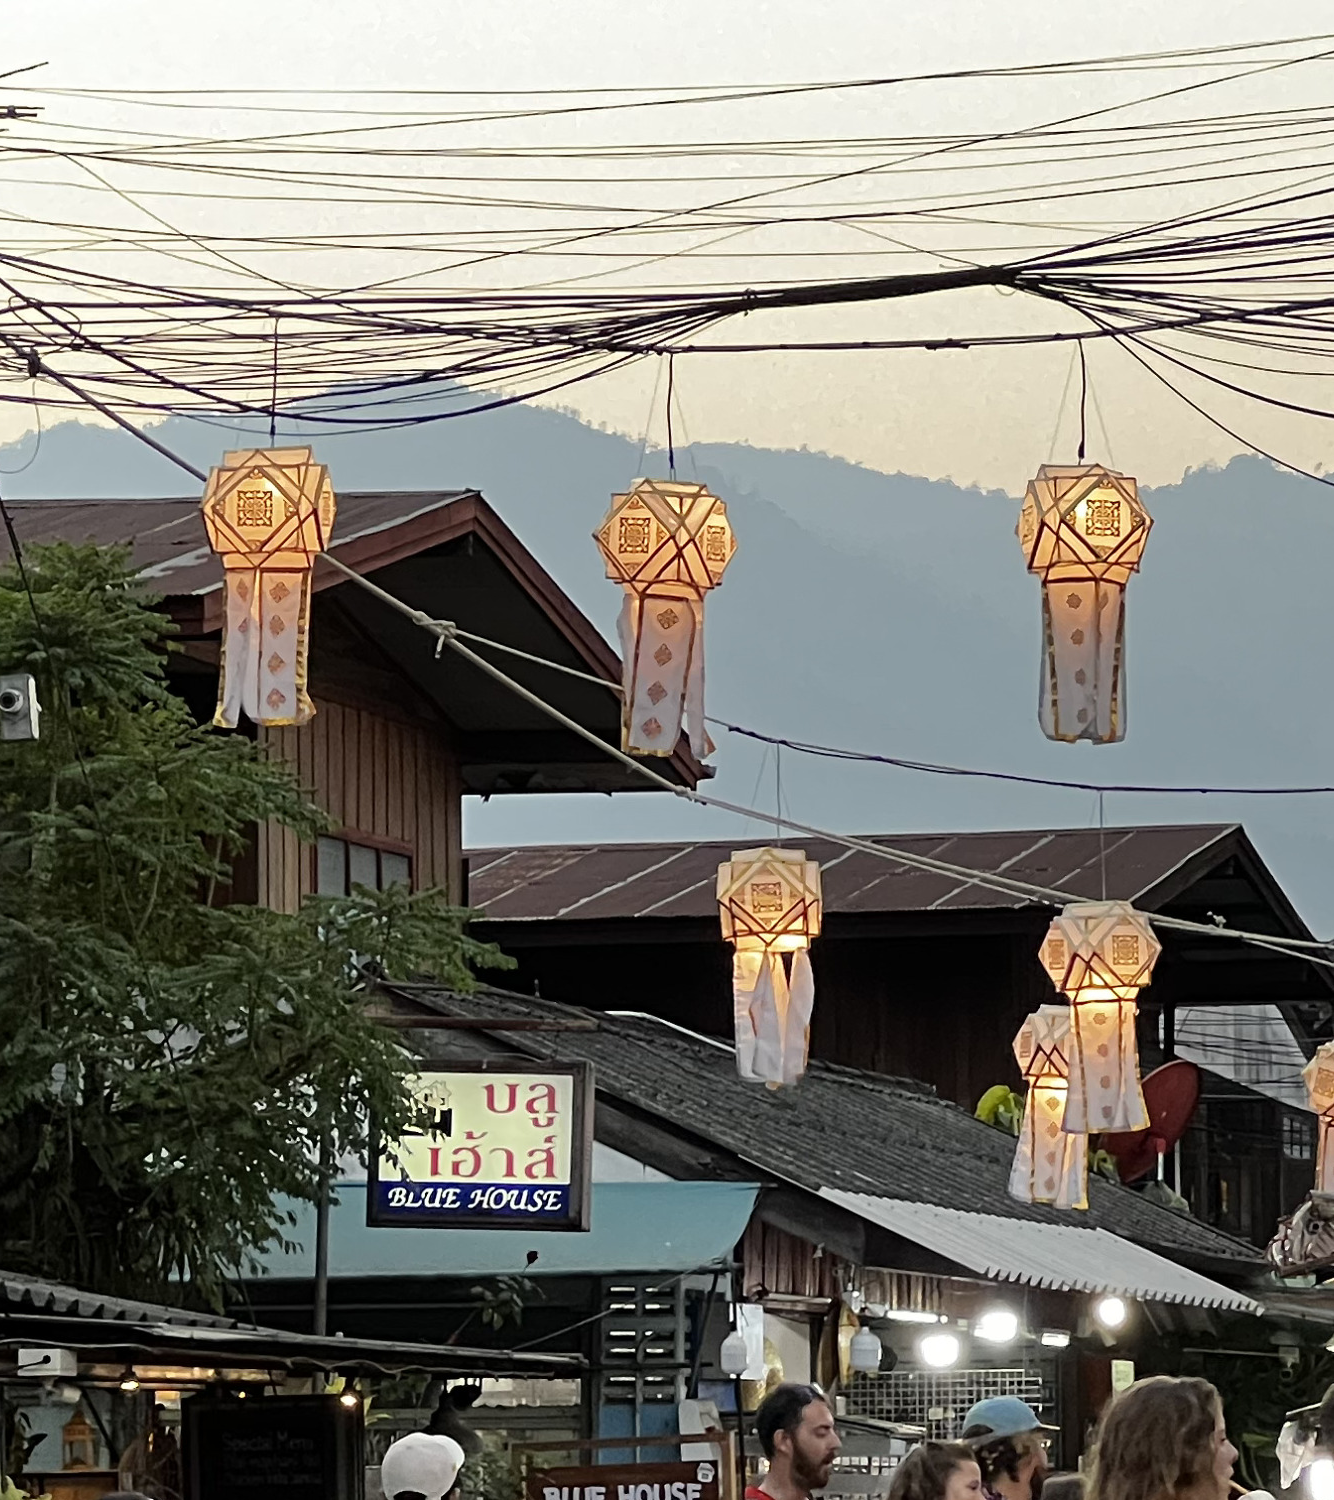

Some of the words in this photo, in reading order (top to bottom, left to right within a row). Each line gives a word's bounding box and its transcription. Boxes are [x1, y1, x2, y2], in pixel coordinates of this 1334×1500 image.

[483, 1083, 559, 1128] บลู
[428, 1131, 558, 1180] เฮ้าส์
[387, 1187, 461, 1209] BLUE
[467, 1187, 562, 1212] HOUSE
